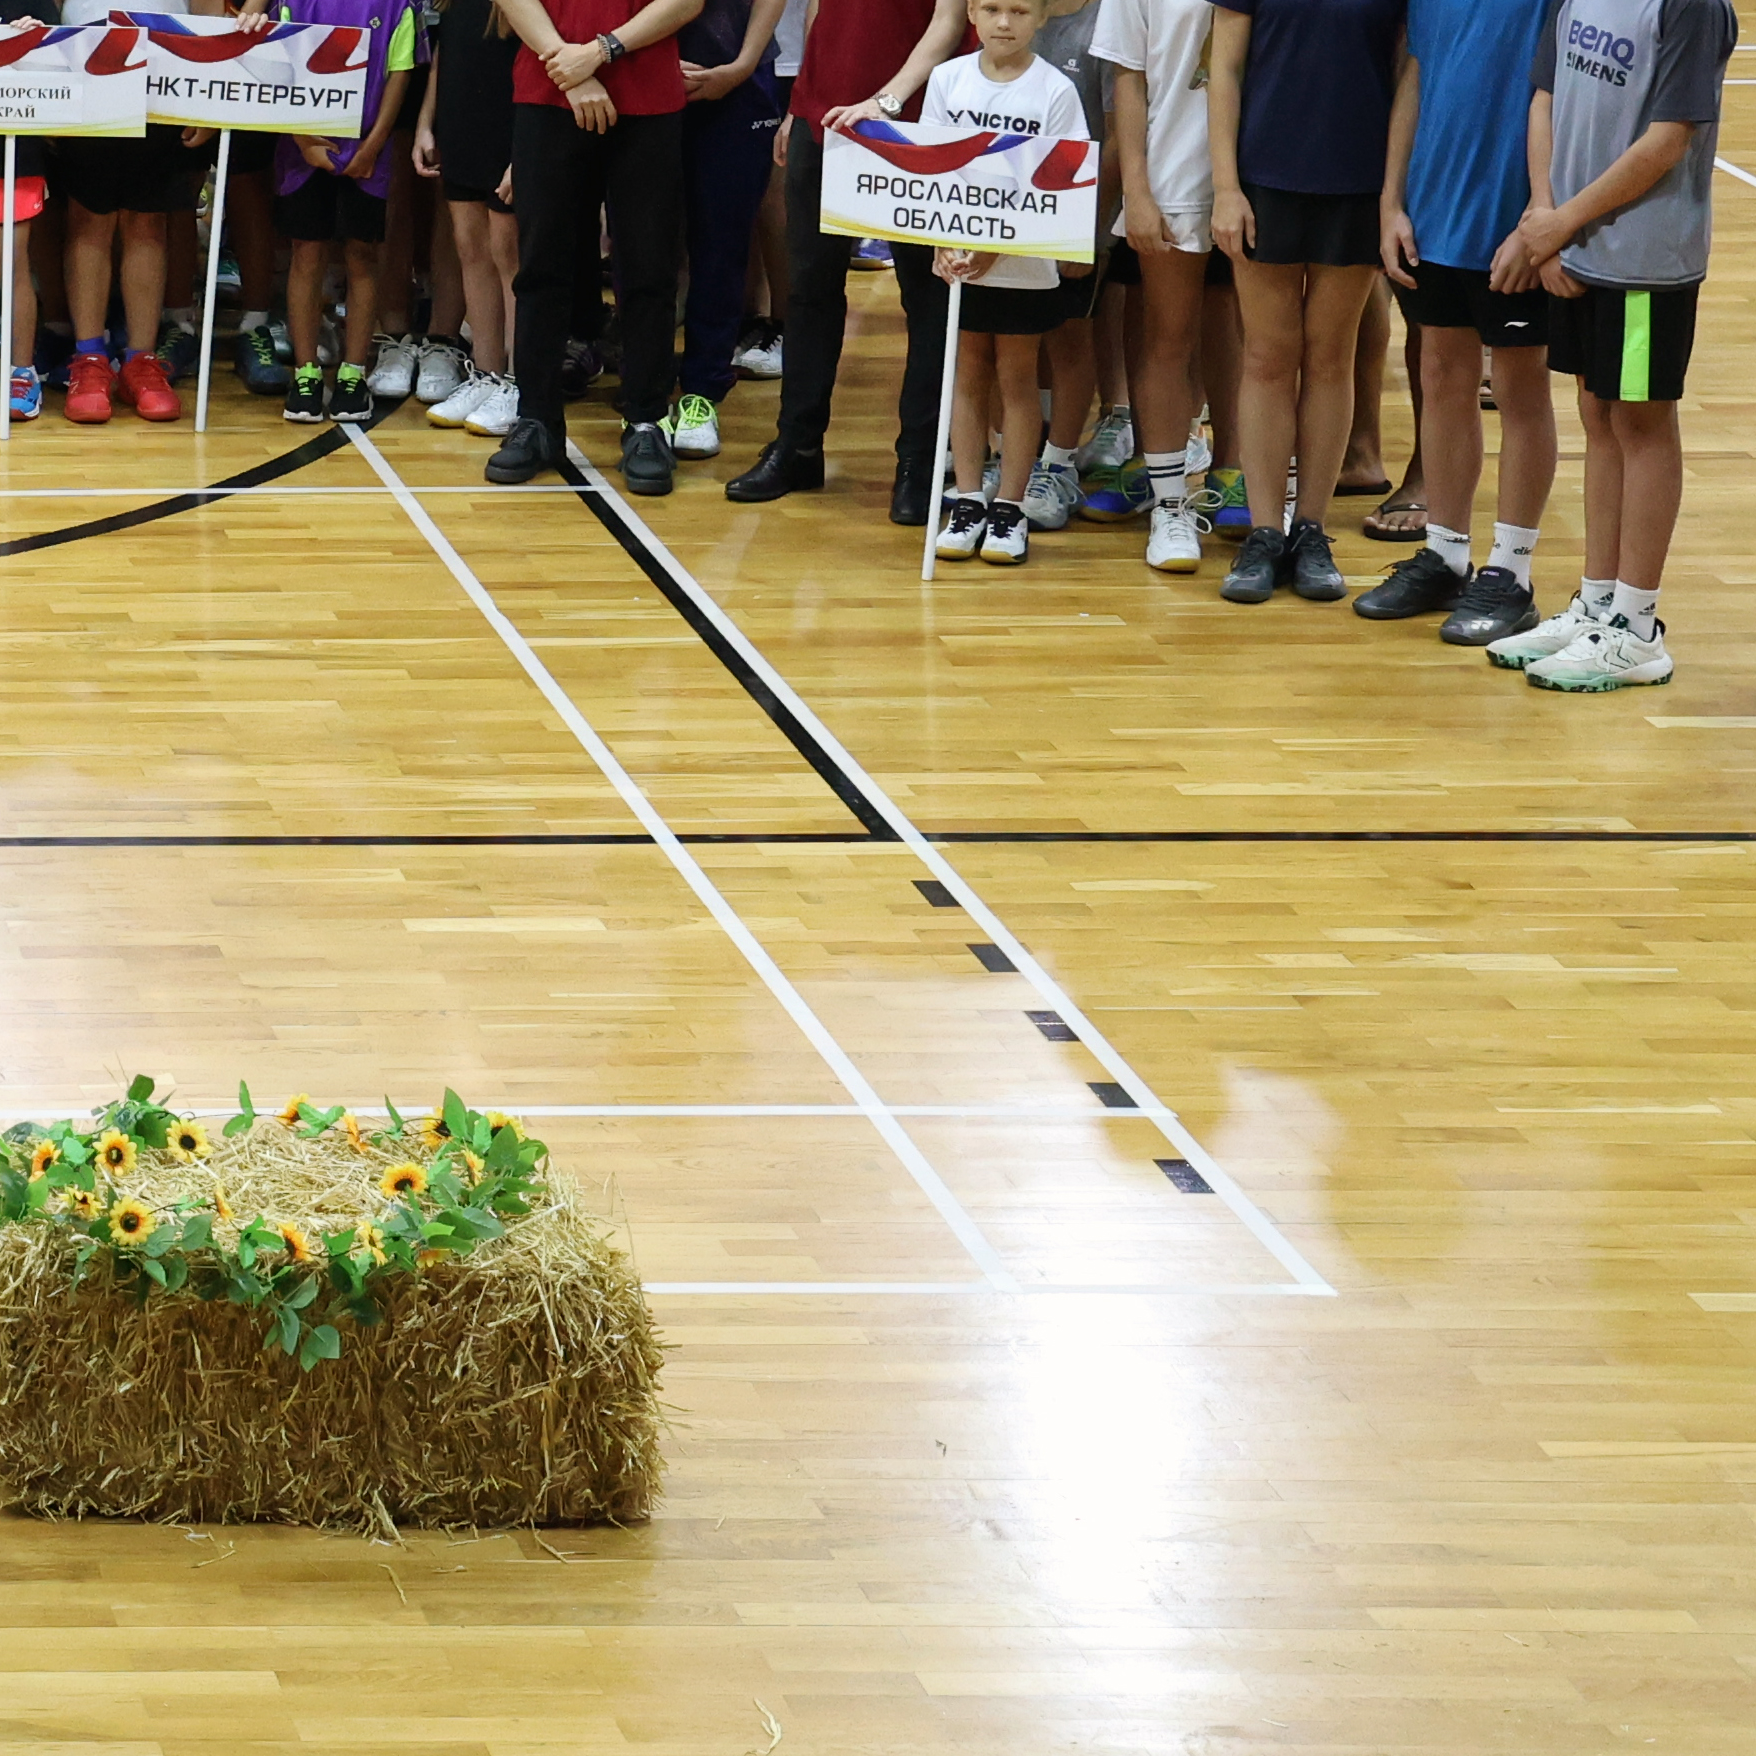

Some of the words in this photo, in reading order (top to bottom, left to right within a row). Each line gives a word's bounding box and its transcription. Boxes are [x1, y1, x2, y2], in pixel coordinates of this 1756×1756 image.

[1568, 19, 1636, 72] BenQ
[145, 77, 359, 111] НКТ-ПЕТЕРБУРГ
[967, 110, 1042, 137] VICTOR
[856, 173, 1058, 215] ЯРОСЛАВСКАЯ
[893, 206, 1017, 240] ОБЛАСТЬ
